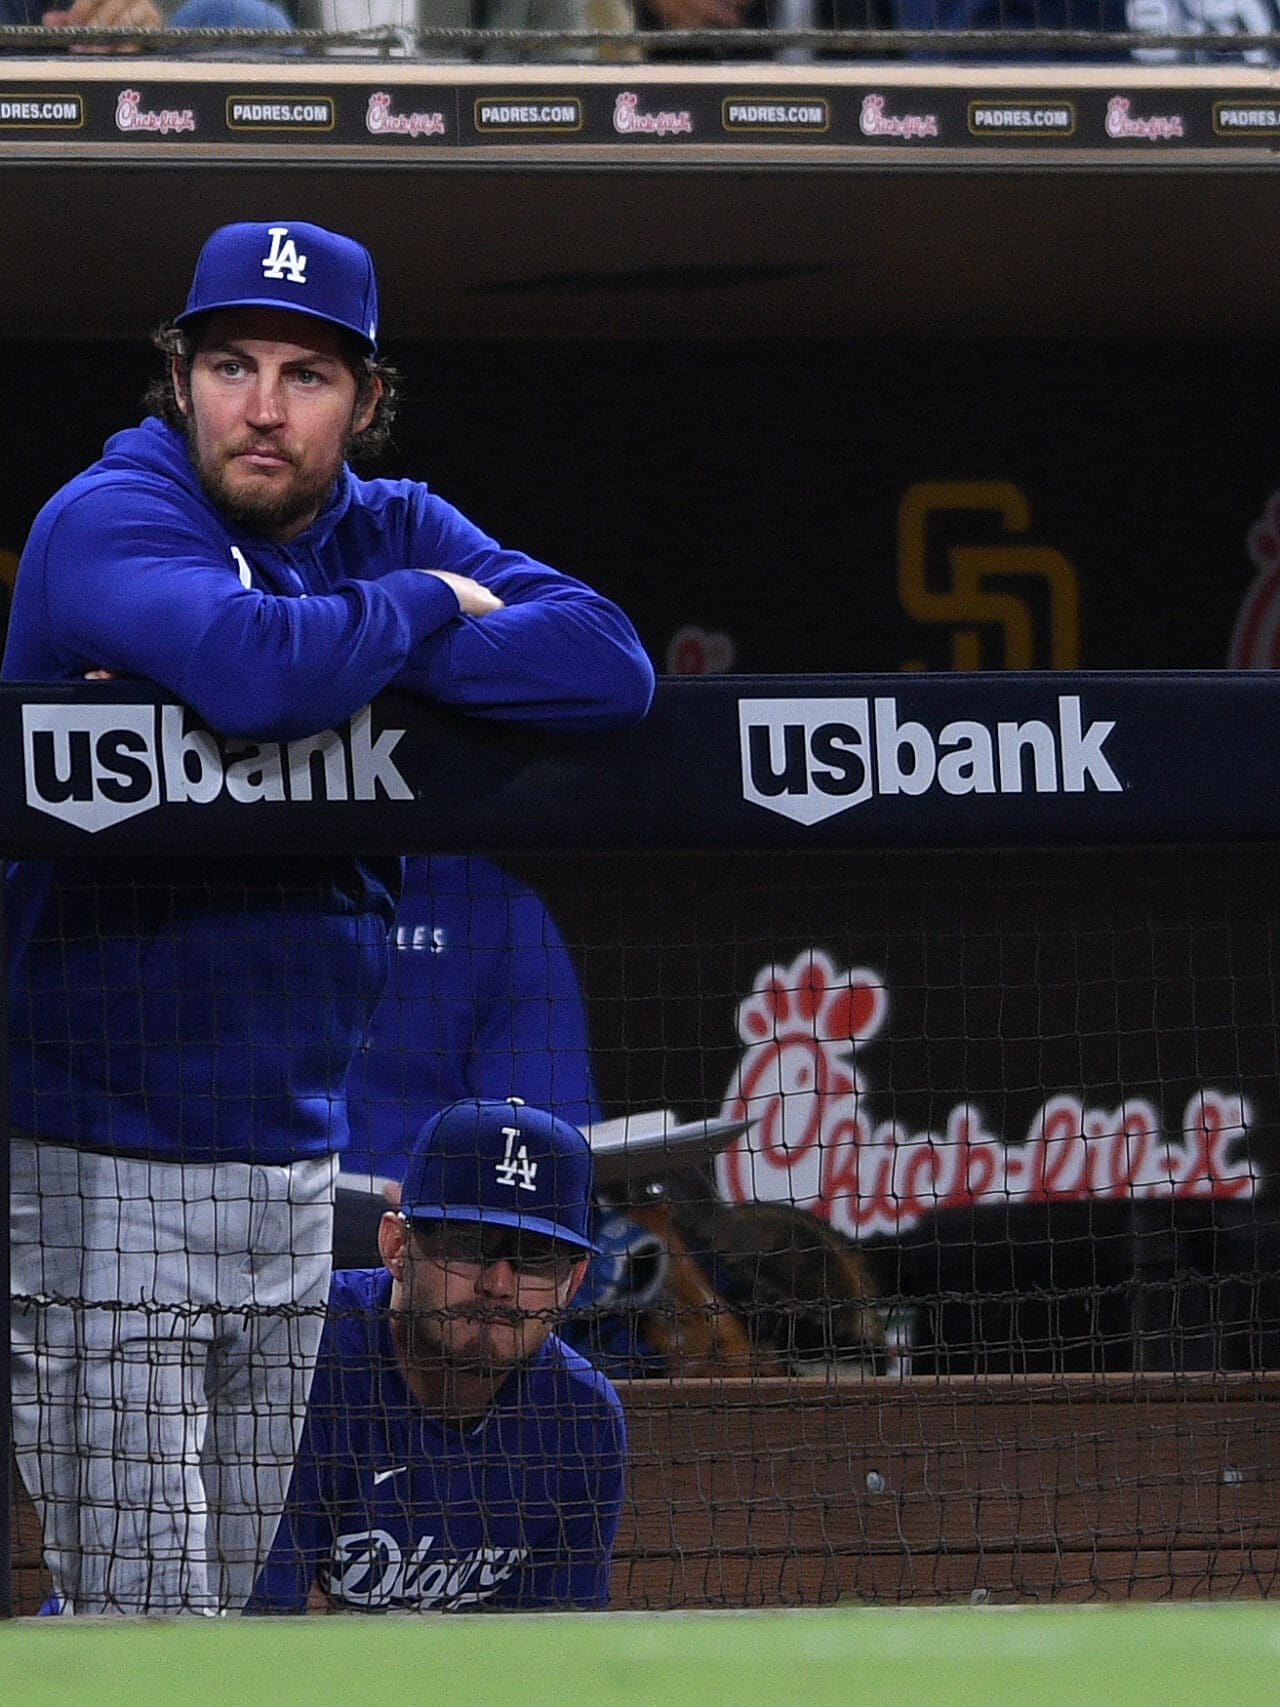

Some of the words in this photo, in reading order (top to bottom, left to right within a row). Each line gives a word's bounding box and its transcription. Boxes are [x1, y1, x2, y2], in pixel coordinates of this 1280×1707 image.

[233, 104, 329, 122] PADRES.COM
[481, 106, 576, 123] PADRES.COM
[729, 105, 823, 123] PADRES.COM
[974, 109, 1069, 127] PADRES.COM
[1220, 109, 1280, 127] PADRES.
[262, 227, 307, 284] LA
[28, 729, 153, 803] us
[161, 704, 414, 803] bank
[747, 721, 866, 797] us
[874, 695, 1124, 795] bank
[495, 1127, 538, 1191] LA
